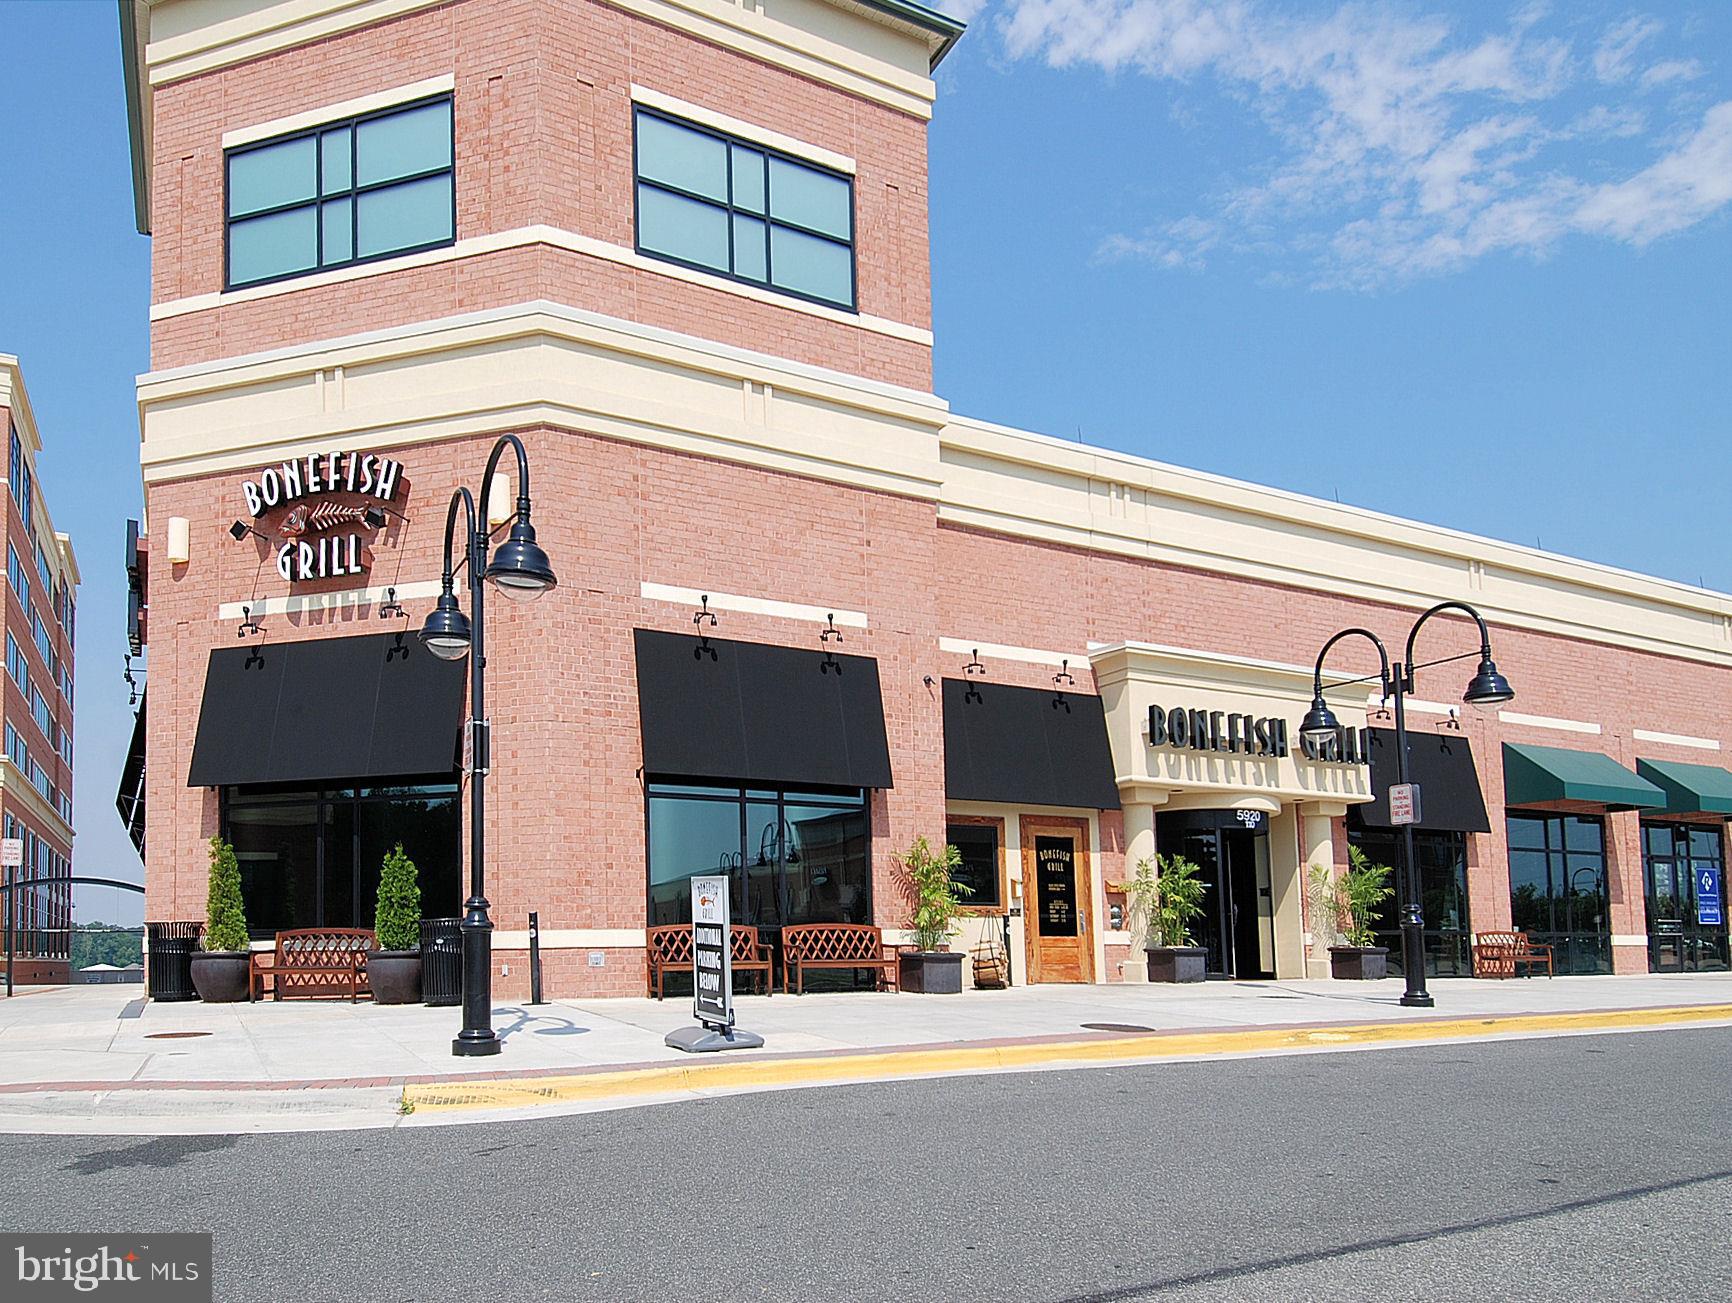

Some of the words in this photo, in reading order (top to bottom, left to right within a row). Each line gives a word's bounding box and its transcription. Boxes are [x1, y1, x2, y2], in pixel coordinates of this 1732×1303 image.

[241, 451, 404, 518] BONEFISH
[276, 534, 363, 582] GRILL
[1149, 704, 1289, 757] BONEFISH
[1236, 809, 1261, 822] 5920
[1040, 849, 1070, 862] BONEFISH
[1047, 862, 1064, 871] GRILL
[697, 950, 721, 969] PARKING
[699, 972, 719, 991] BELOW
